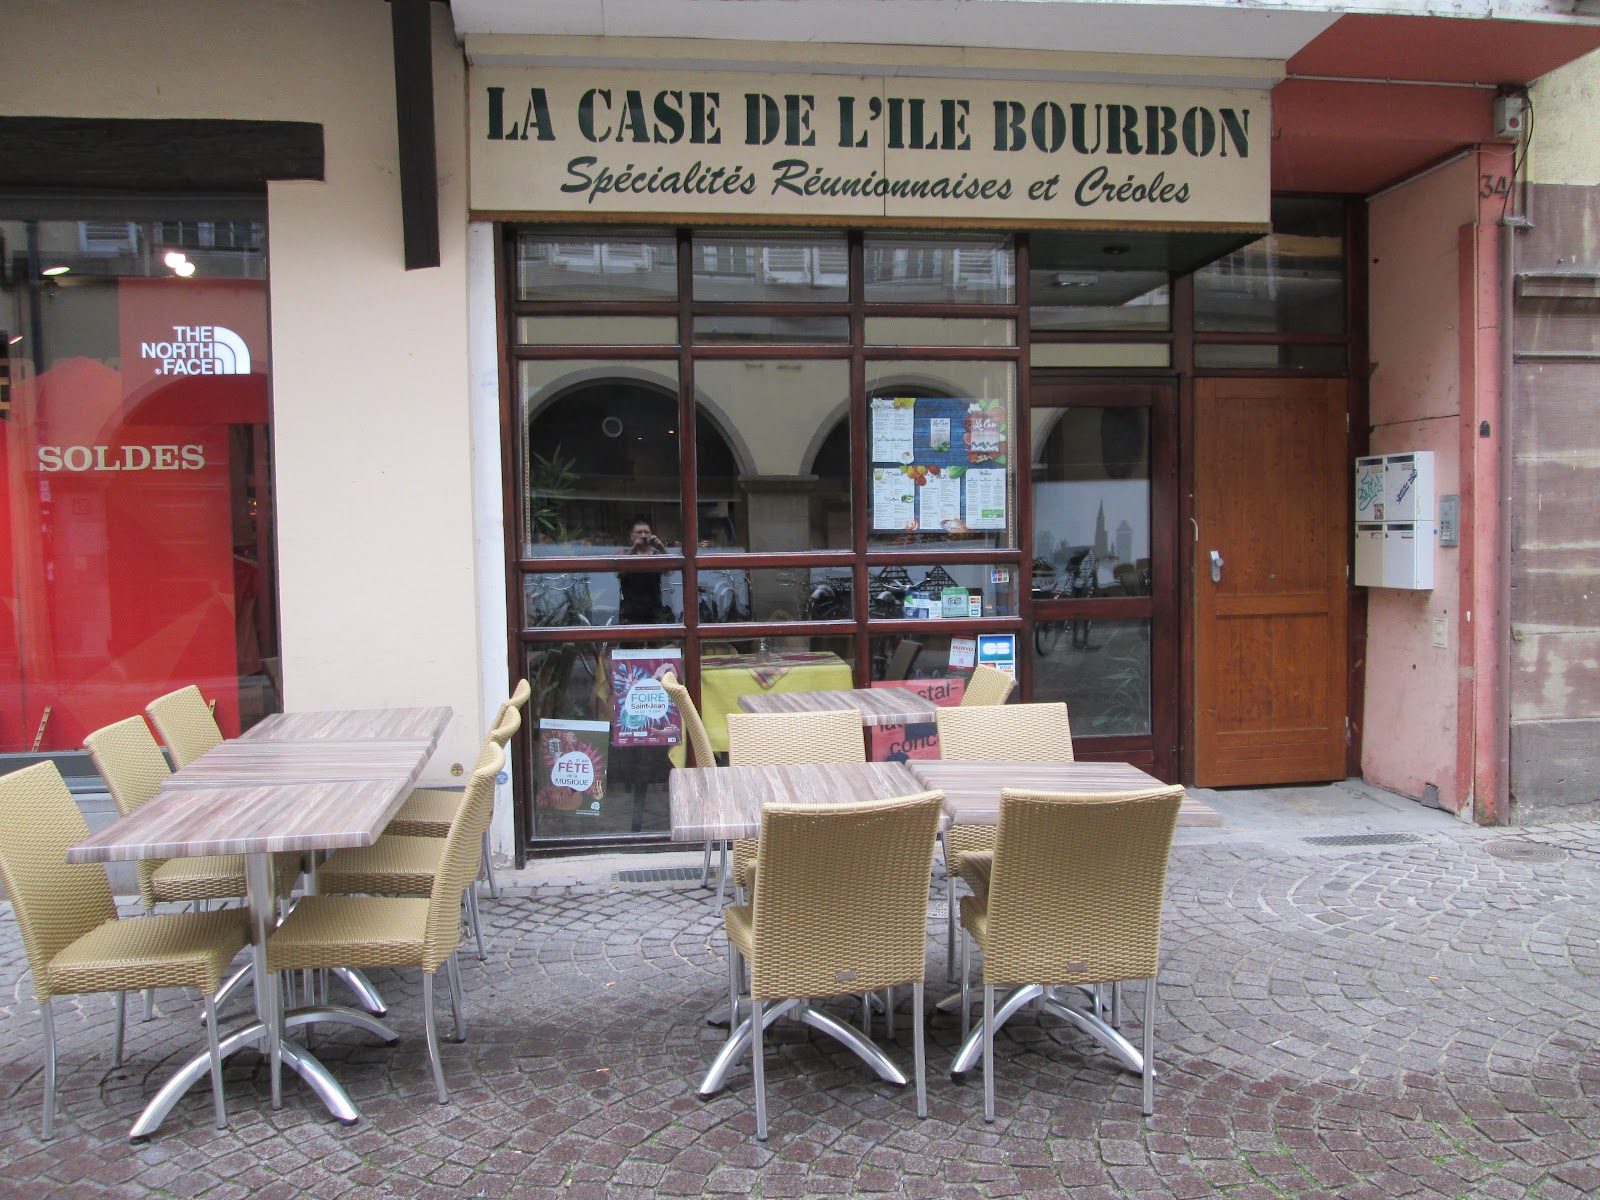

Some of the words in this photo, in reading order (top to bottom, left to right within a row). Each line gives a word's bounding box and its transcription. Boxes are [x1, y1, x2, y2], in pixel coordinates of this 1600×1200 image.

[487, 87, 556, 141] LA
[578, 88, 722, 145] CASE
[744, 93, 816, 147] DE
[838, 96, 971, 151] L'ILE
[993, 100, 1250, 158] BOURBON
[560, 156, 757, 204] Spécialités
[771, 159, 1013, 200] Réunionnaises
[1028, 174, 1059, 200] et
[1075, 166, 1190, 207] Créoles
[1480, 174, 1508, 201] 34
[173, 326, 213, 342] THE
[141, 342, 213, 359] NORTH
[163, 358, 214, 375] FACE
[38, 444, 205, 472] SOLDES
[631, 692, 665, 703] FOIRE
[631, 702, 666, 710] Saint-Jean
[558, 760, 590, 774] FÊTE
[555, 778, 589, 786] MUSIQUE
